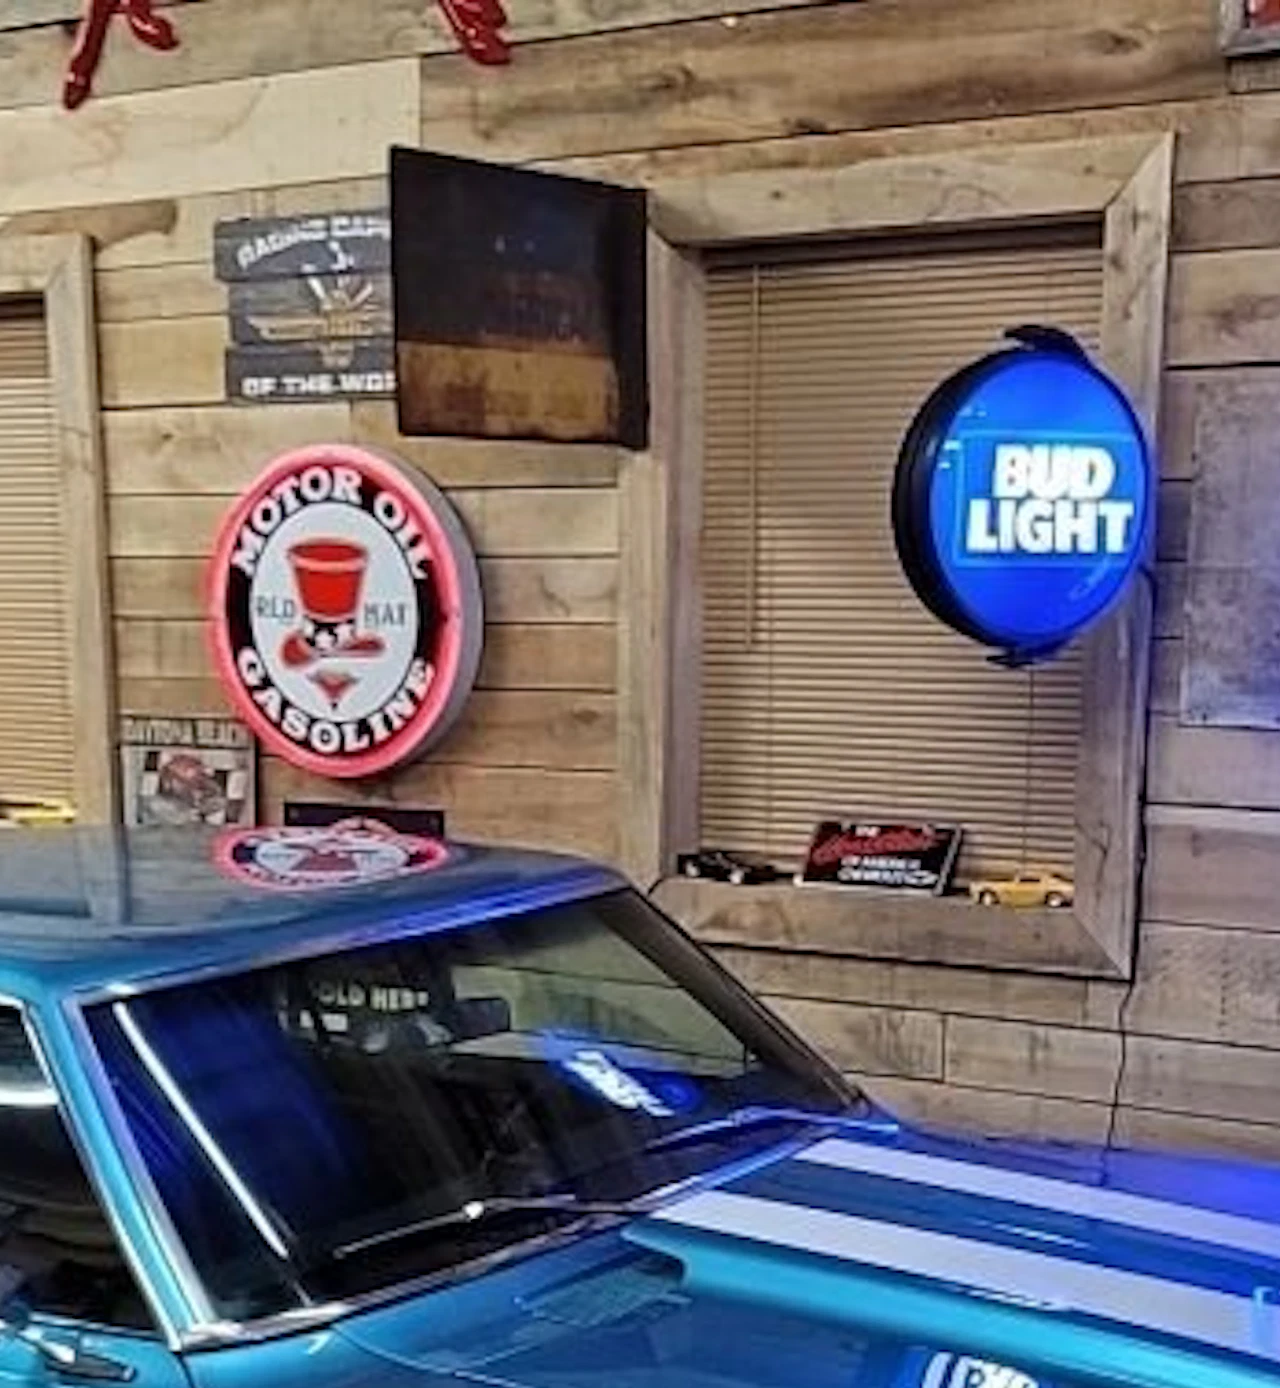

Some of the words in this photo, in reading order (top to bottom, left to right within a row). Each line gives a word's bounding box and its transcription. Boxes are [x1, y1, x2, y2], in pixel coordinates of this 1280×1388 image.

[993, 443, 1116, 498] BUD
[231, 466, 363, 576] MOTOR
[373, 491, 436, 580] OIL
[966, 498, 1135, 554] LIGHT
[237, 646, 436, 753] GASOLINE
